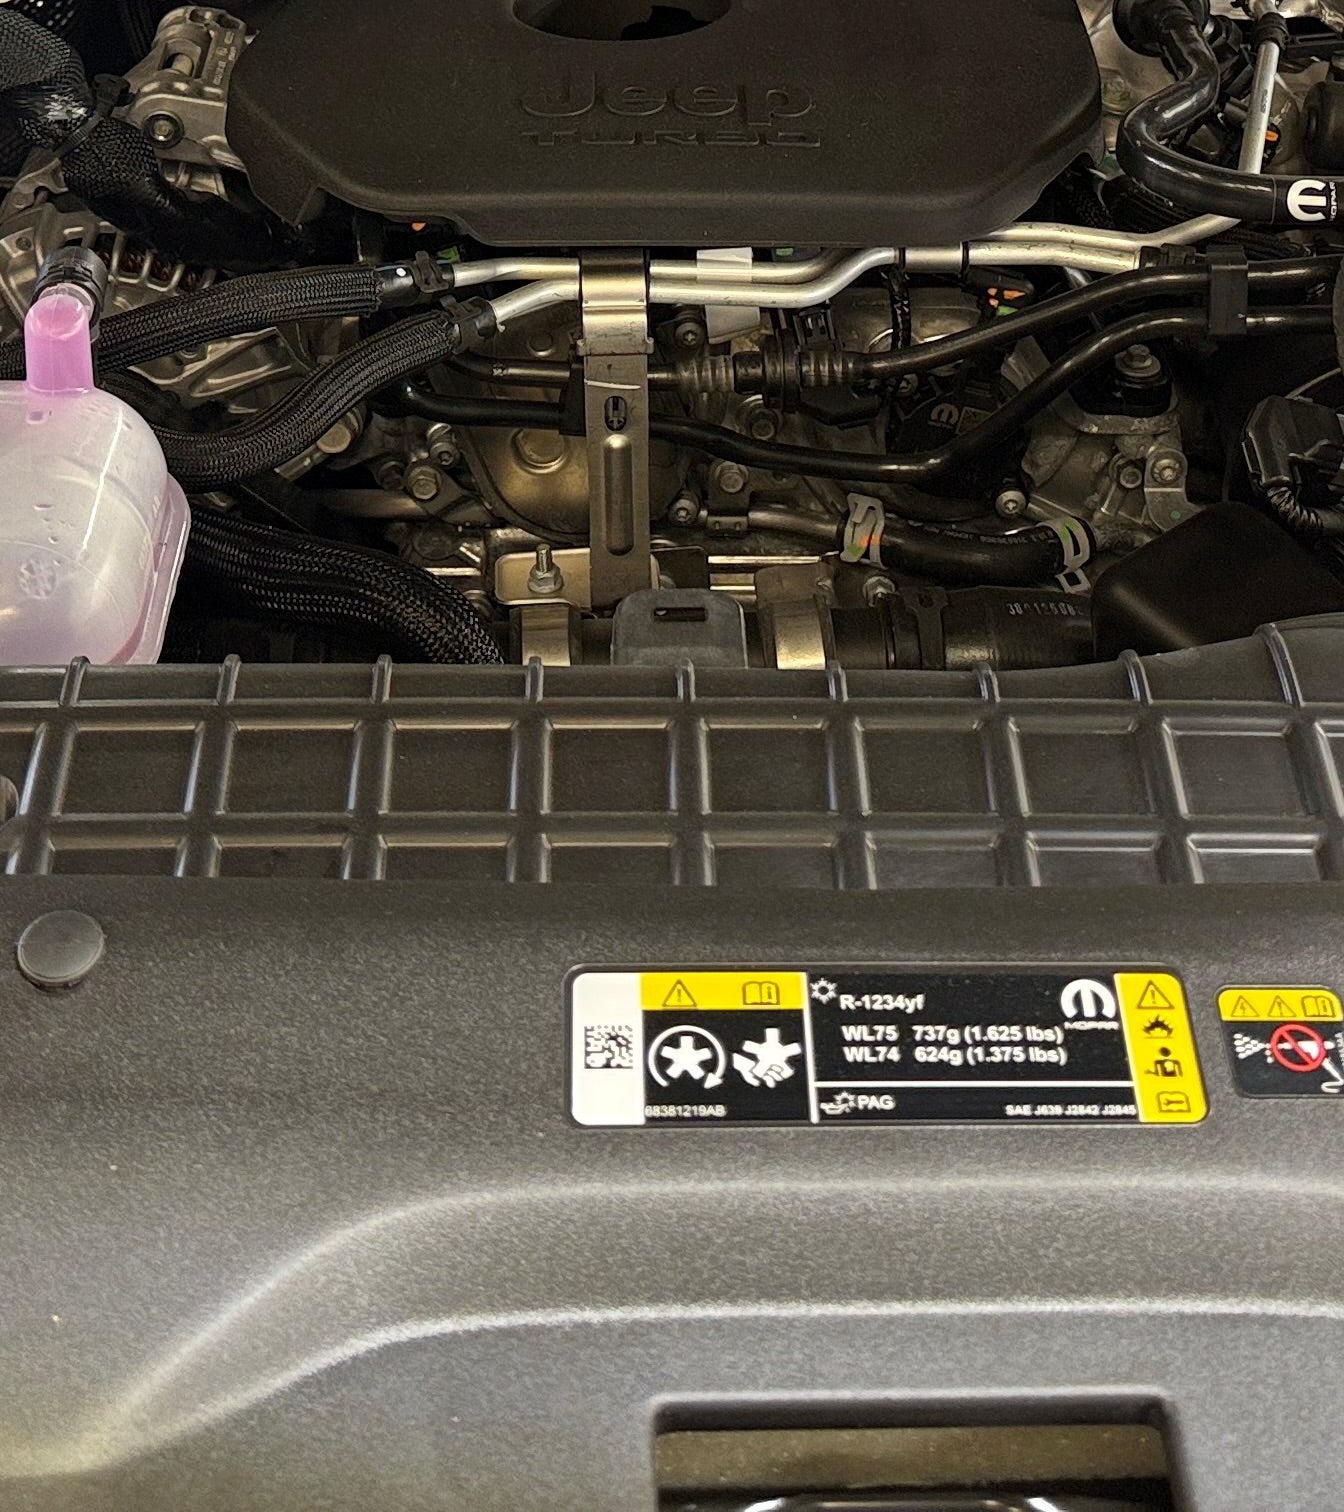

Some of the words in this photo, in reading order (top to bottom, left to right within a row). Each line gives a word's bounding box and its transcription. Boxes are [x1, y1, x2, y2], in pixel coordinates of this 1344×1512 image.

[518, 66, 816, 126] Jeep
[520, 130, 821, 147] TURBO
[840, 994, 926, 1014] R-1234yf
[841, 1025, 899, 1041] WL75
[912, 1025, 958, 1045] 737g
[963, 1024, 1023, 1045] (1.625
[1026, 1024, 1065, 1045] lbs)
[1063, 1020, 1120, 1031] MOPAR
[843, 1046, 901, 1063] WL74
[914, 1046, 963, 1066] 624g
[966, 1046, 1026, 1066] (1.375
[1029, 1046, 1068, 1066] lbs)
[857, 1094, 897, 1110] PAG
[1005, 1104, 1033, 1116] SAE
